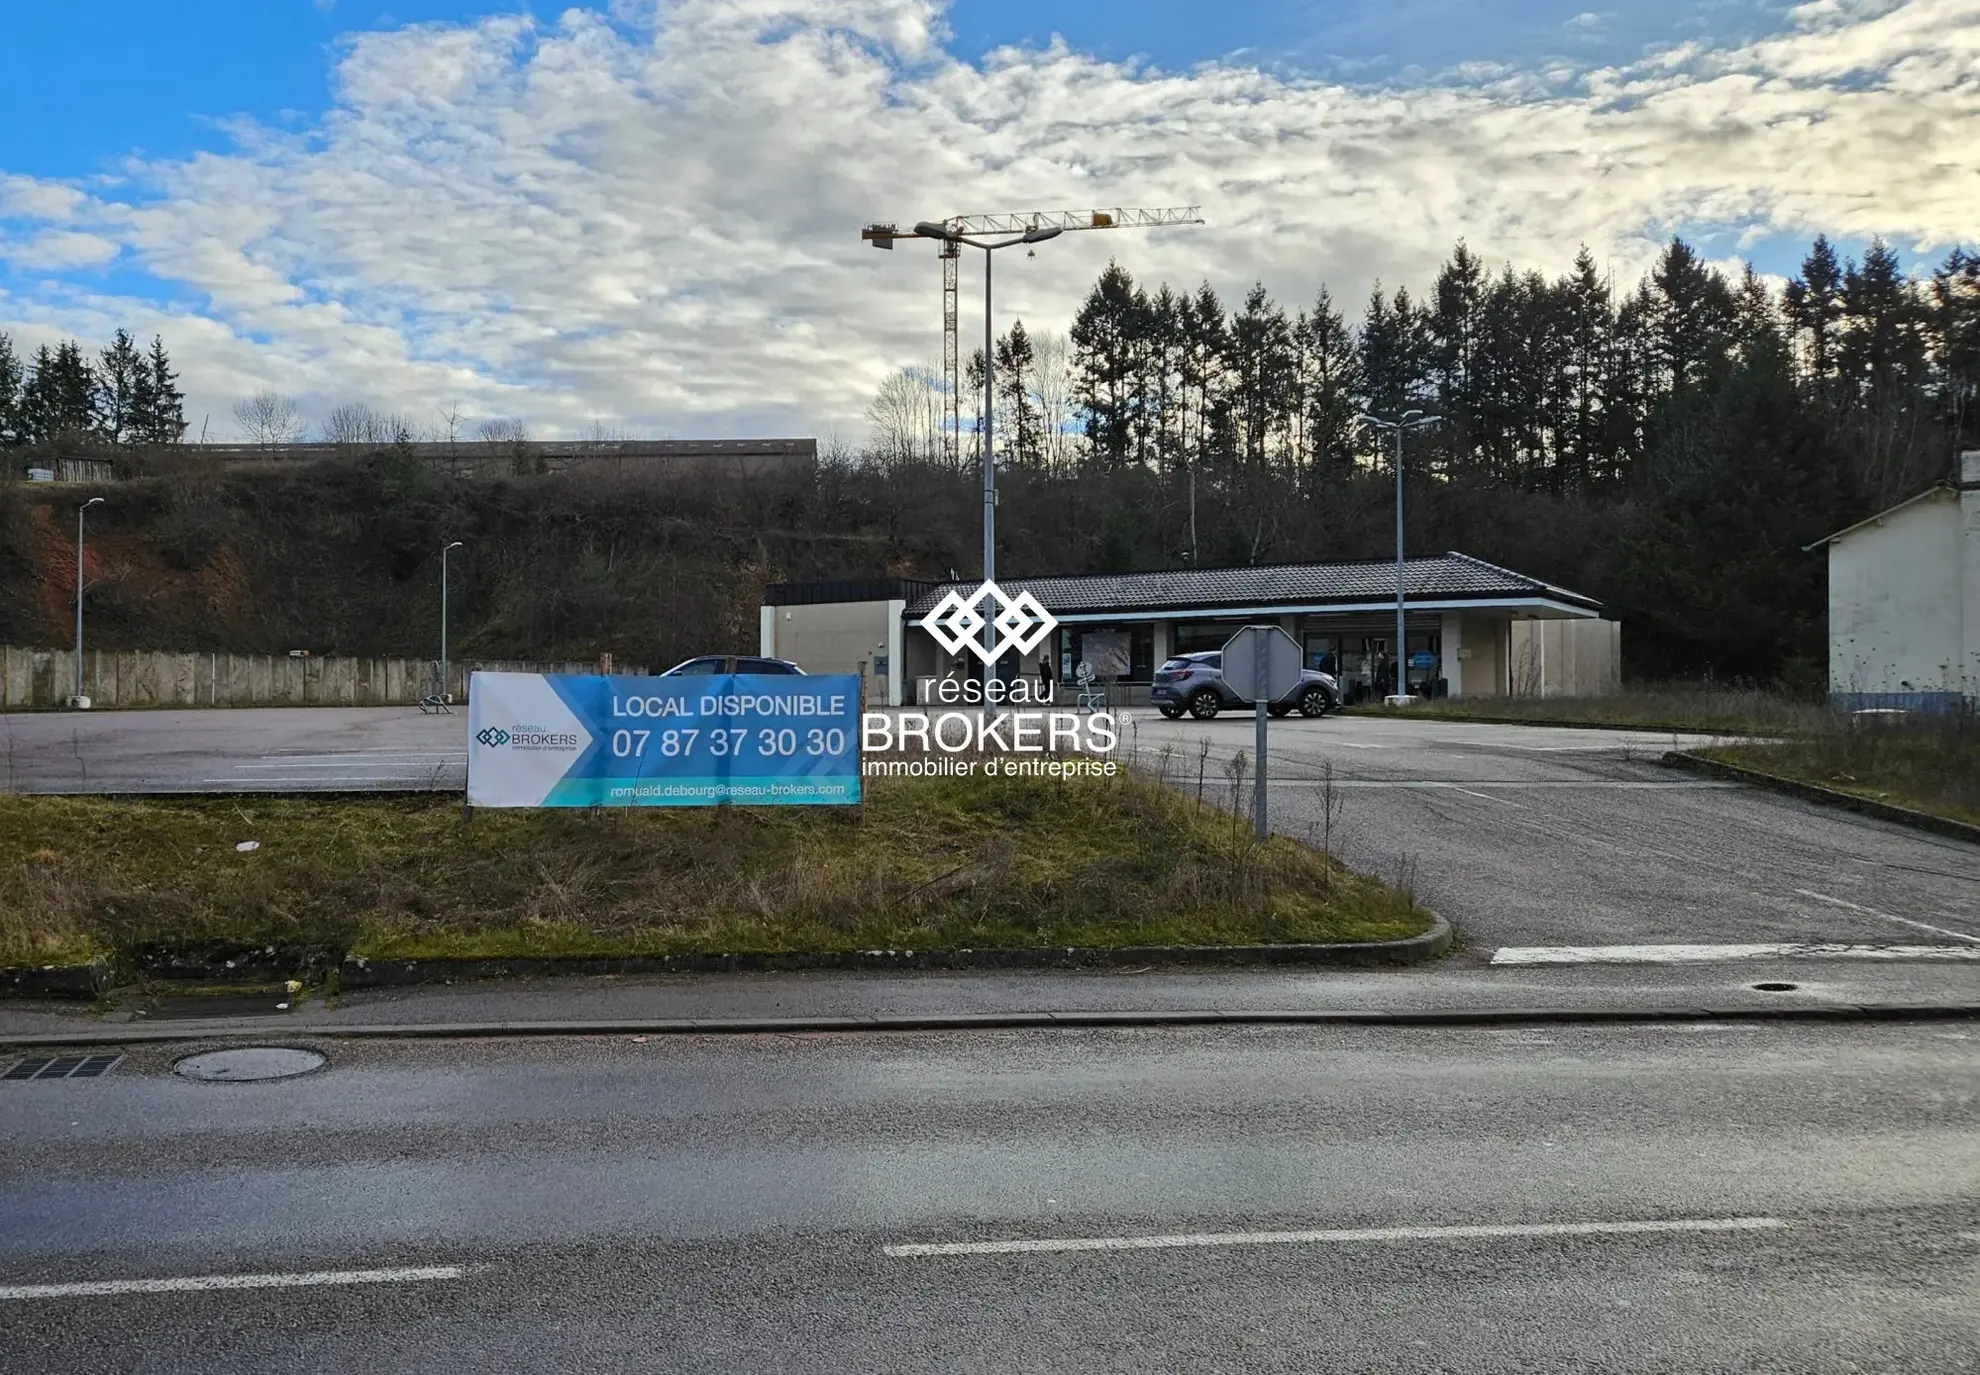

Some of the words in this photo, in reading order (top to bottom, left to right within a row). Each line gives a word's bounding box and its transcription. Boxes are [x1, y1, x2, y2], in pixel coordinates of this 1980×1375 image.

[613, 695, 694, 717] LOCAL
[700, 695, 845, 716] DISPONIBLE
[511, 723, 546, 733] réseau
[511, 734, 577, 745] BROKERS
[612, 729, 651, 757] 07
[661, 728, 700, 757] 87
[709, 728, 748, 756] 37
[758, 728, 797, 756] 30
[806, 728, 845, 756] 30
[610, 784, 845, 798] romuald.debourg@reseau-brokers.com
